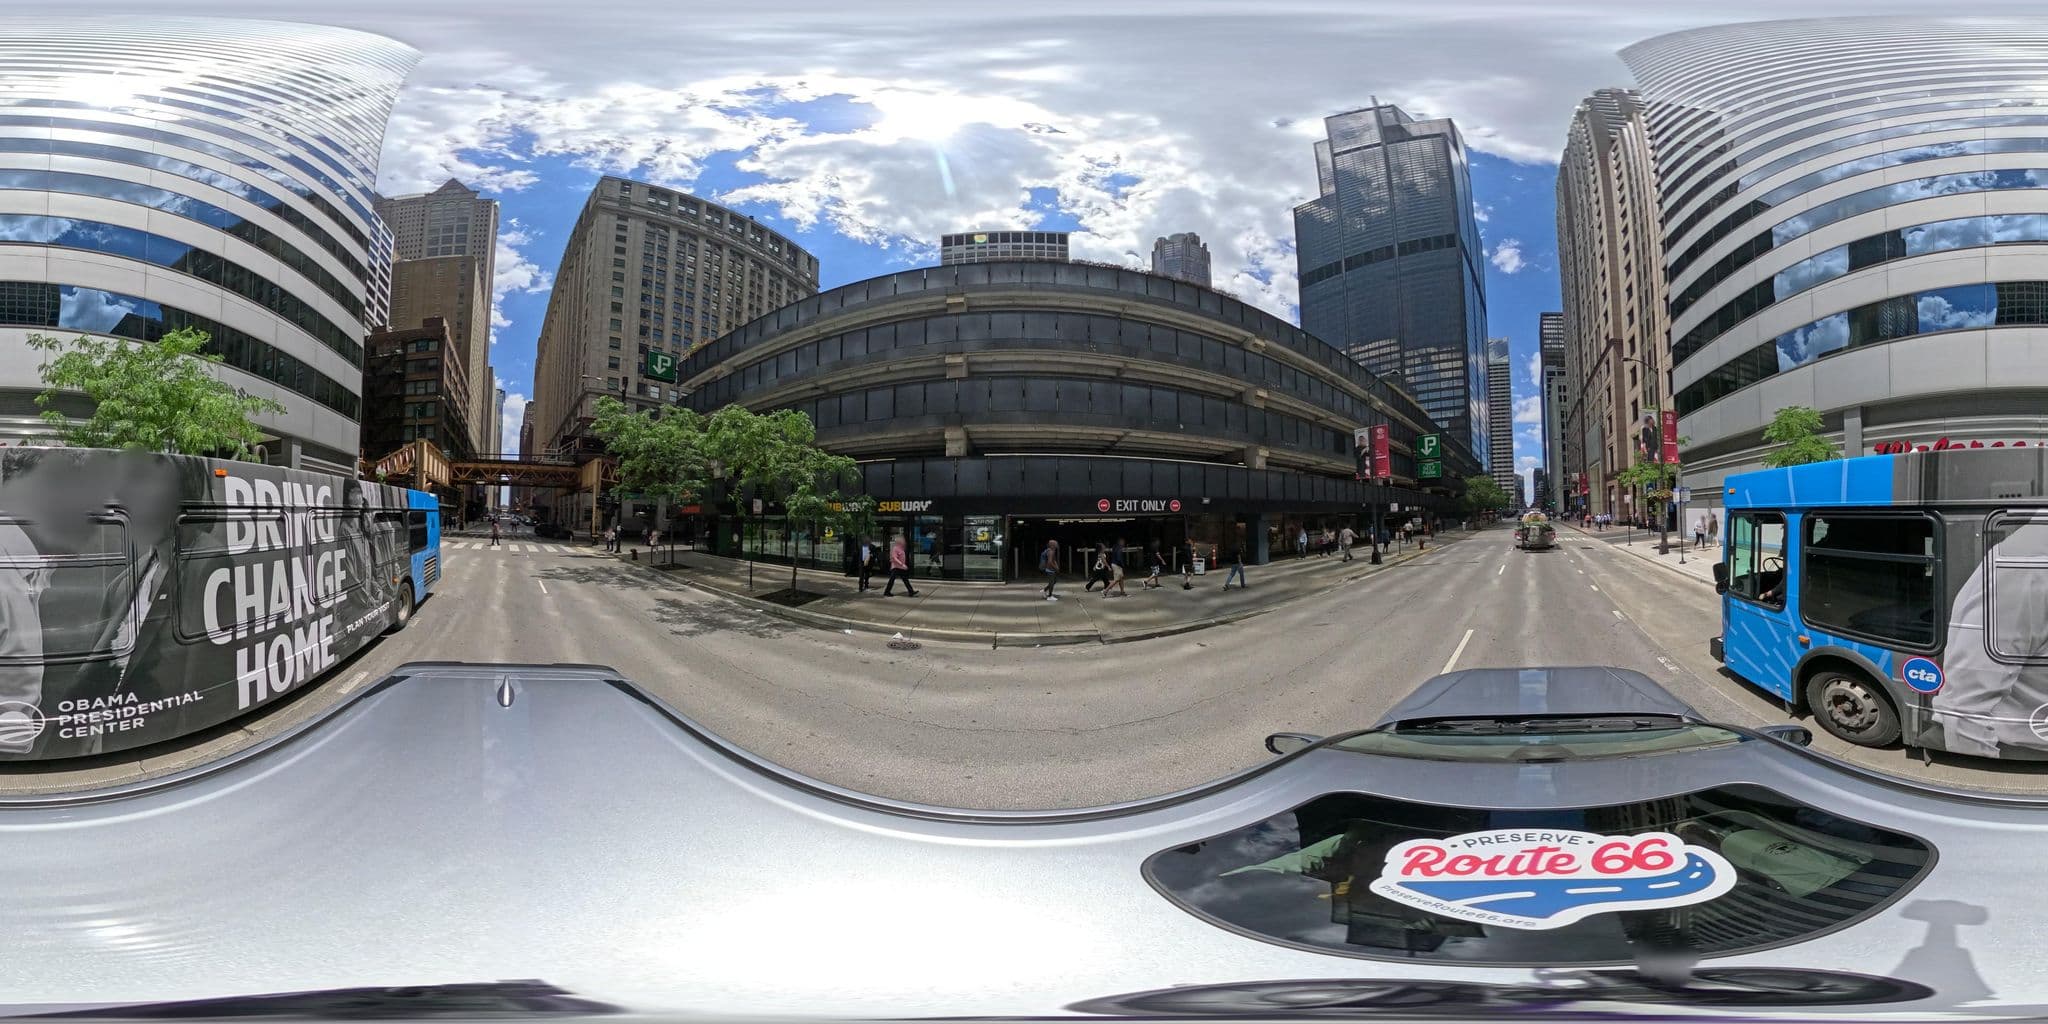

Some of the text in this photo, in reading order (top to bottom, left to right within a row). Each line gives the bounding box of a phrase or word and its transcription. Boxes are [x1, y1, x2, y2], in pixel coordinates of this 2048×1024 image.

[224, 475, 335, 555] BRING
[878, 500, 932, 512] SUBWAY
[1116, 499, 1167, 512] EXIT ONLY
[203, 548, 348, 645] CHANGE
[346, 618, 364, 634] PLAN
[363, 609, 379, 623] YOUR
[236, 614, 335, 711] HOME
[1908, 669, 1937, 683] cta
[58, 691, 139, 713] OBAMA
[58, 690, 204, 726] PRESIDENTIAL
[59, 717, 145, 739] CENTER
[1463, 832, 1583, 848] PRESERVE
[1401, 838, 1674, 877] Route 66
